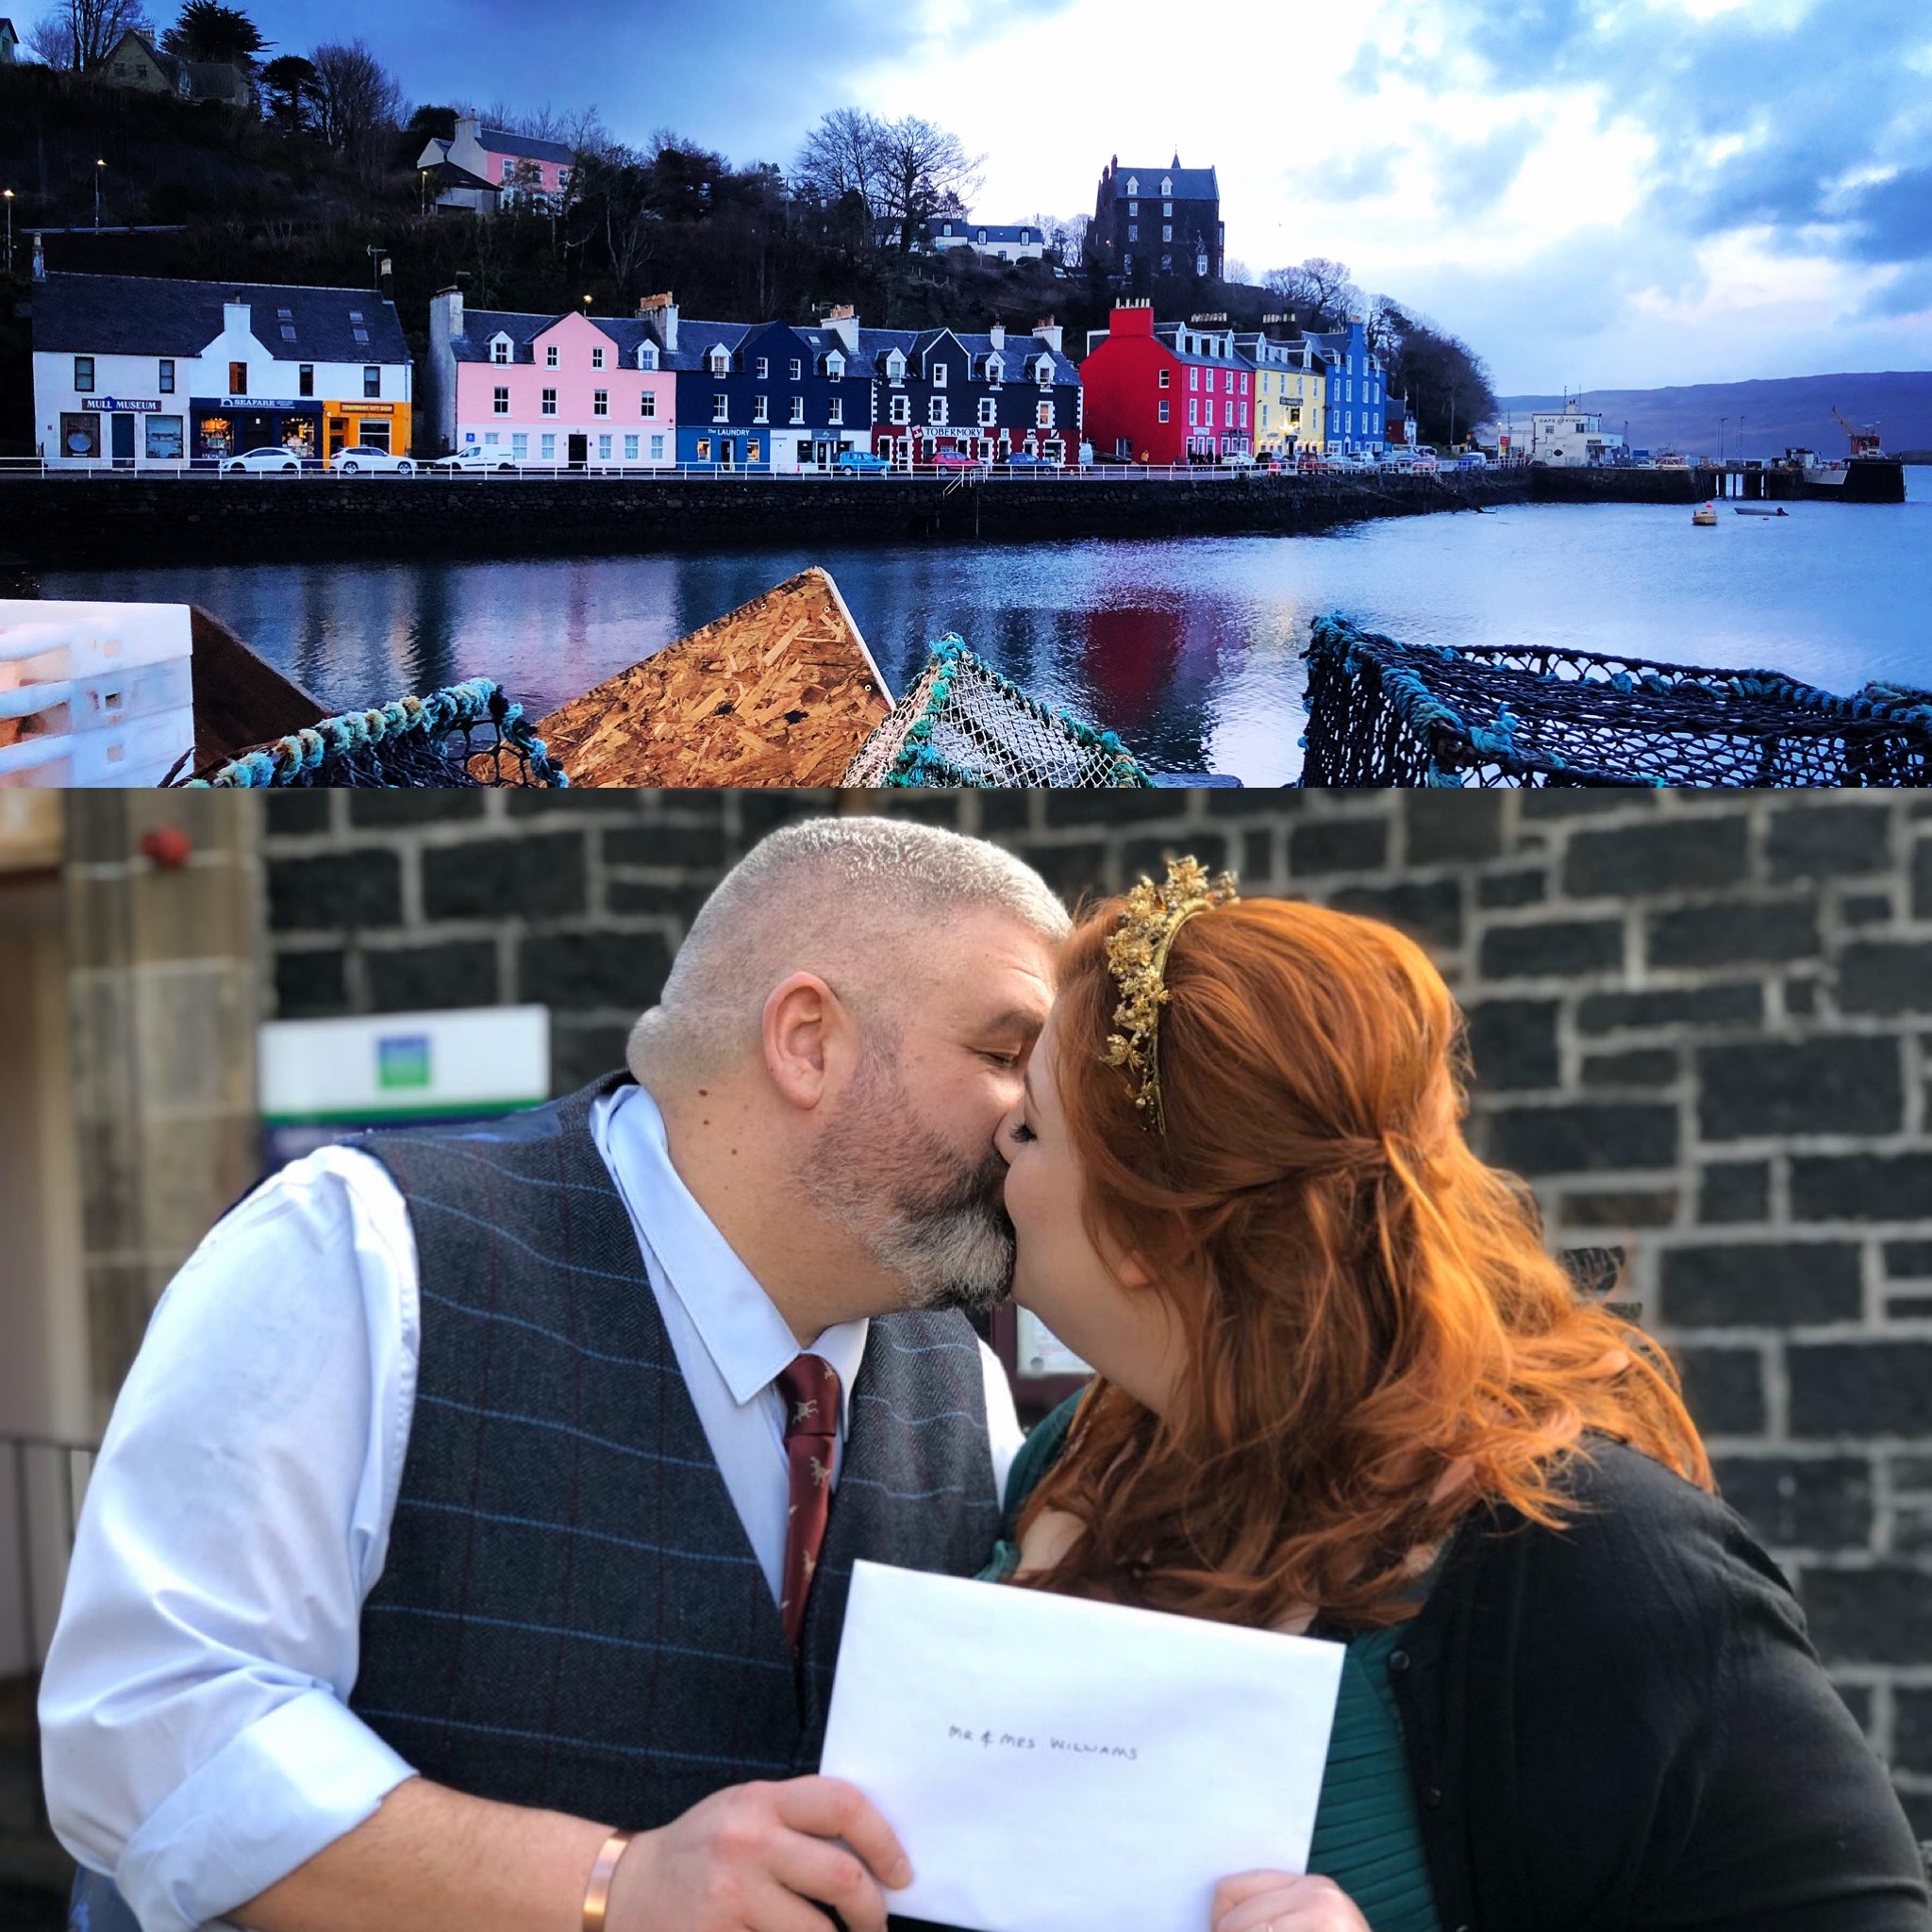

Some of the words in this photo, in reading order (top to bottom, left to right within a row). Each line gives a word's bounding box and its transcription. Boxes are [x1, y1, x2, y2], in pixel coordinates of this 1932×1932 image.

[87, 400, 113, 409] MULL
[115, 401, 157, 409] MUSEUM
[717, 428, 751, 437] LAUNDRY
[924, 427, 983, 437] TOBERMORY
[980, 1729, 992, 1749] &
